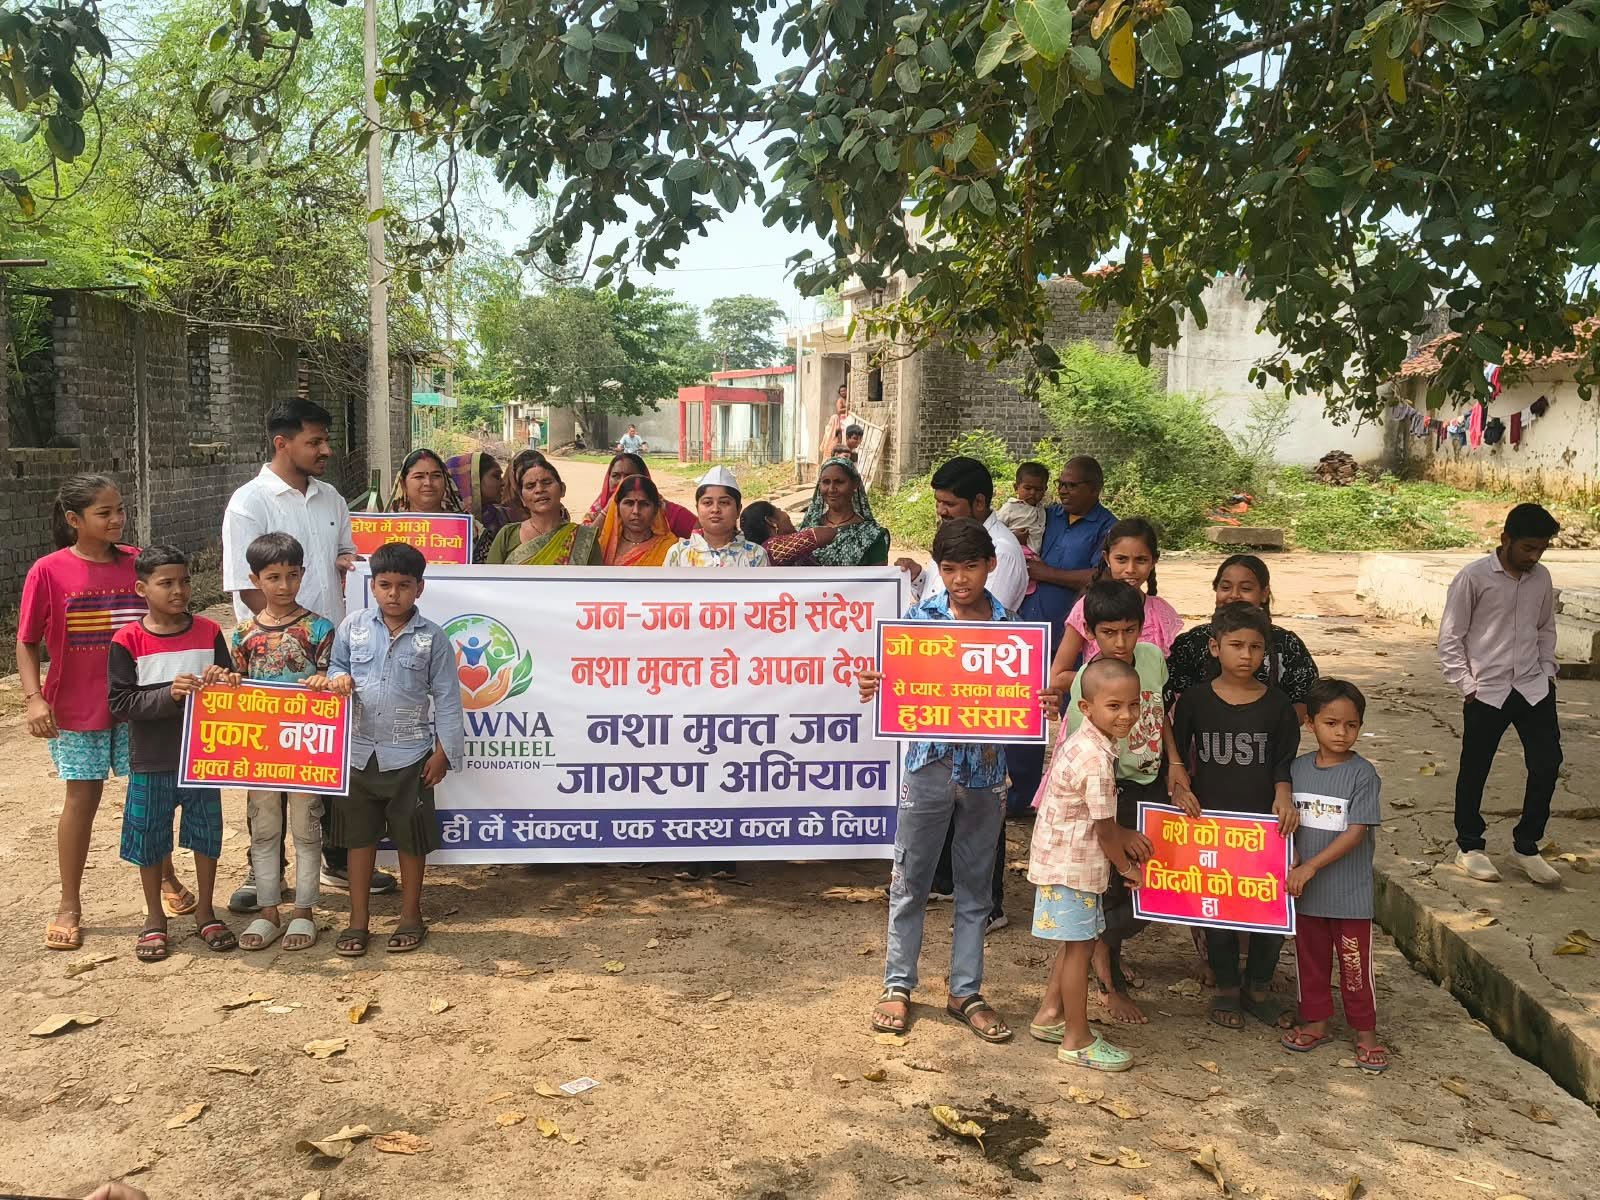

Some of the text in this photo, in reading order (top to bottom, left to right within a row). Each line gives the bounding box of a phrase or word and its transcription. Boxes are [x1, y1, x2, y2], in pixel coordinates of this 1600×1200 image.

[381, 518, 392, 533] में
[396, 519, 431, 533] आओ
[415, 533, 427, 548] में
[431, 533, 463, 549] जियो
[576, 592, 874, 633] जन-जन का यही संदेश
[571, 657, 630, 688] नशा
[637, 657, 703, 695] मुक्त
[709, 648, 740, 689] हो
[747, 656, 826, 686] अपना
[886, 633, 1033, 678] जो करे नशे
[202, 689, 340, 719] युवा शक्ति की यही
[892, 678, 906, 697] से
[950, 683, 993, 698] उसका
[996, 682, 1032, 699] बर्बाद
[463, 711, 555, 737] WNA
[898, 699, 1031, 731] हुआ संसार
[200, 720, 336, 754] पुकार, नशा
[463, 740, 556, 757] TISHEEL
[587, 713, 862, 755] नशा मुक्त जन
[1200, 732, 1268, 766] JUST
[192, 757, 340, 784] मुक्त हो अपना संसार
[467, 760, 540, 770] FOUNDATION
[556, 750, 890, 795] जागरण अभियान
[442, 810, 887, 843] ही लें संकल्प, एक स्वस्थ कल के लिए!
[1162, 816, 1266, 852] नशे को कहो
[1198, 850, 1218, 869] ना
[1145, 859, 1278, 902] जिंदगी को कहो
[1201, 897, 1219, 917] हा
